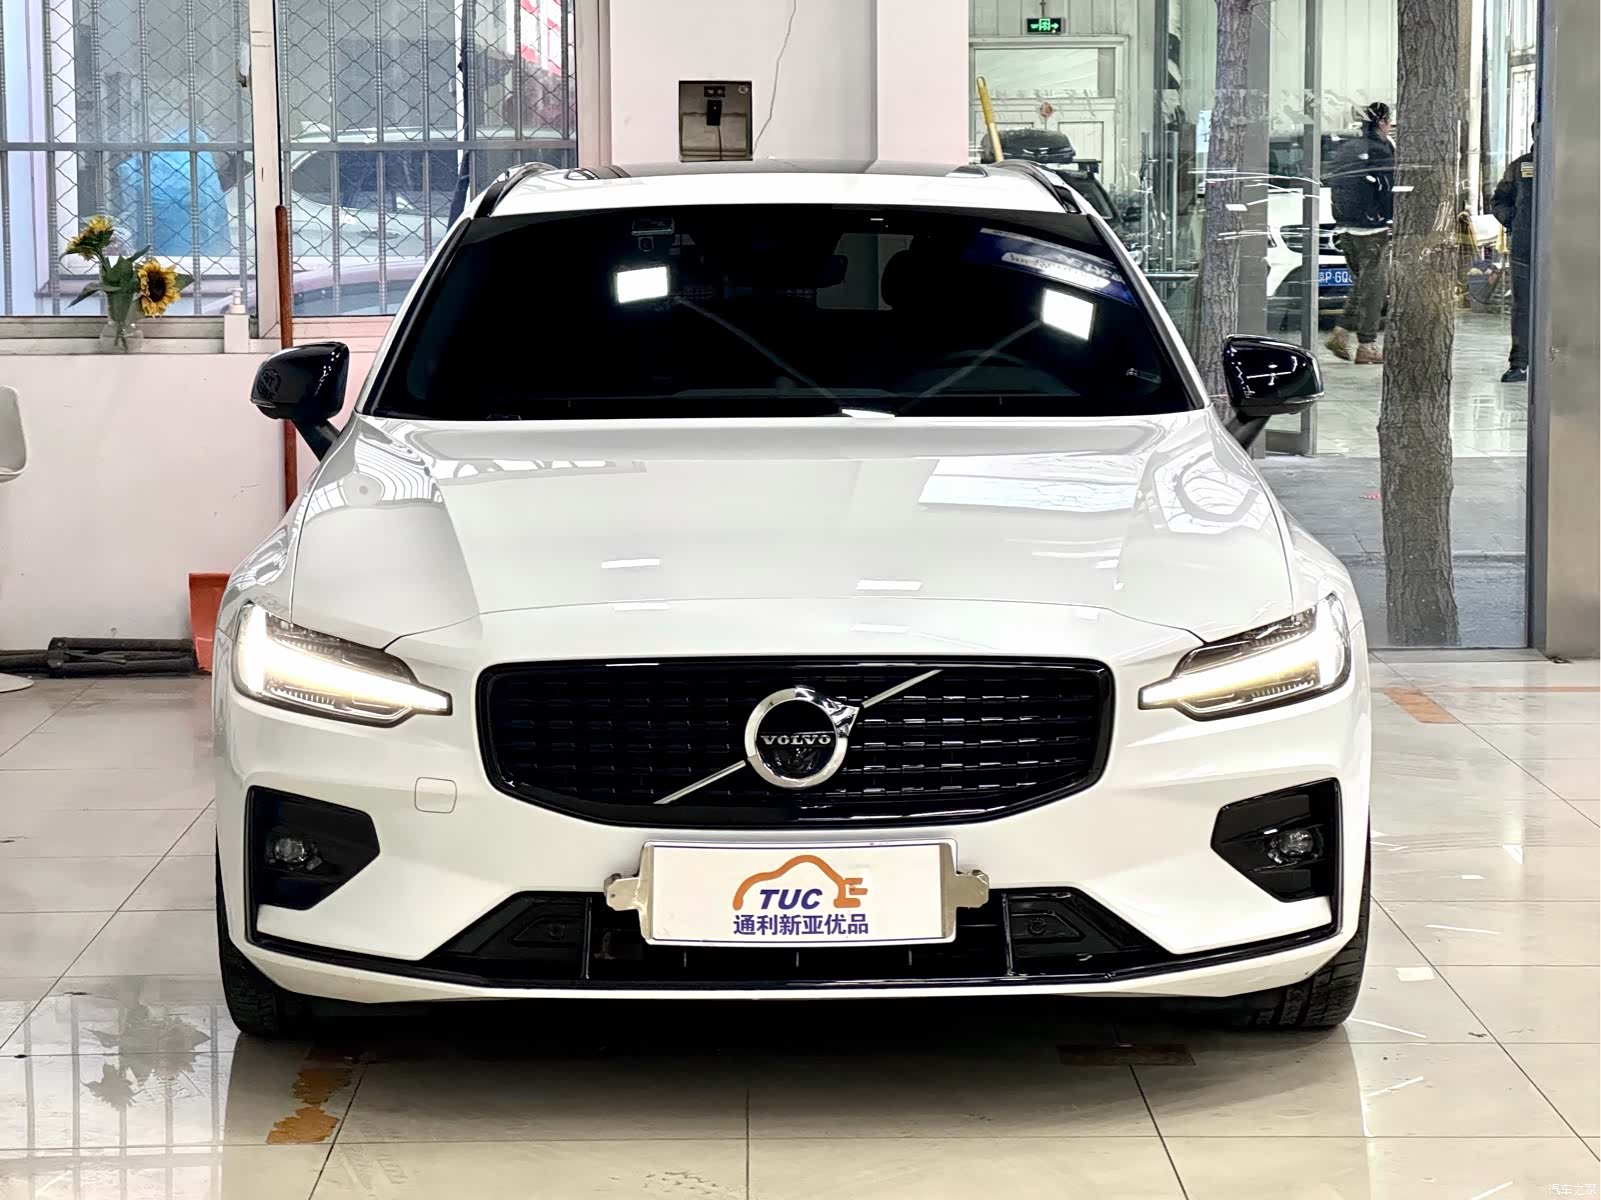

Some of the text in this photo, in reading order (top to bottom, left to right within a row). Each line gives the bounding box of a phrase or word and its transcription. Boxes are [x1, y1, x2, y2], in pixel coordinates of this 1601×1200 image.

[760, 734, 831, 745] VOLVO
[759, 888, 823, 910] TUC
[732, 913, 869, 936] 通利新亚优品
